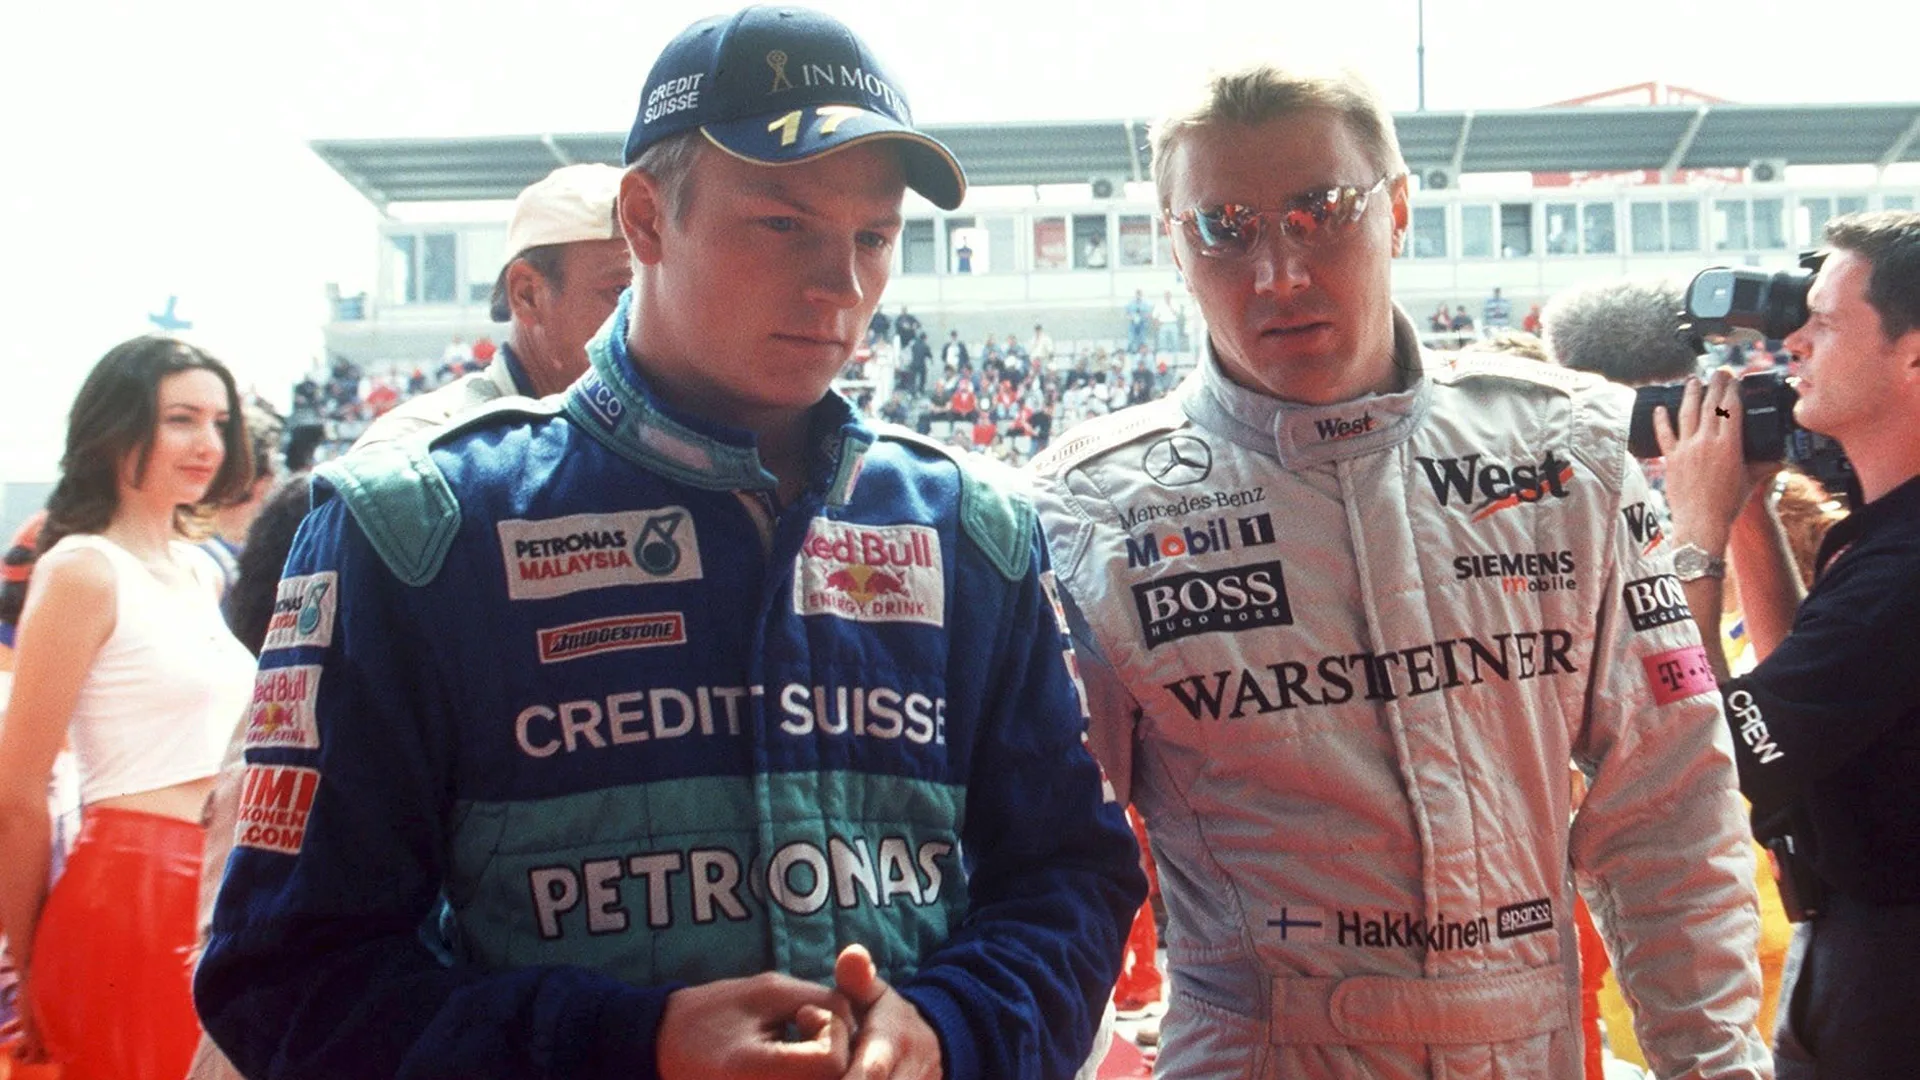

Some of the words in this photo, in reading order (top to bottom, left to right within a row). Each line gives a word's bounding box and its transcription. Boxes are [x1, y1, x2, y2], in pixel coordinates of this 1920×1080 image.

[647, 73, 704, 107] CREDIT
[802, 64, 835, 86] IN
[643, 91, 700, 125] SUISSE
[767, 105, 863, 147] 17
[1313, 411, 1373, 440] West
[1415, 450, 1574, 507] West
[1118, 487, 1266, 531] Mercedes-Benz
[515, 531, 627, 558] PETRONAS
[861, 530, 933, 568] Bull
[1125, 518, 1230, 568] Mobil
[1242, 515, 1267, 545] 1
[519, 550, 632, 580] MALAYSIA
[1453, 551, 1575, 579] SIEMENS
[1143, 571, 1278, 625] BOSS
[1501, 576, 1577, 593] mobile
[872, 601, 926, 616] DRINK
[1151, 613, 1209, 637] HUGO
[1223, 606, 1281, 625] BOSS
[551, 622, 676, 653] BRIDGESTONE
[278, 668, 307, 701] Bull
[1163, 629, 1579, 722] WARSTEINER
[515, 684, 763, 759] CREDIT
[780, 682, 947, 745] SUISSE
[1727, 689, 1785, 764] CREW
[528, 837, 952, 940] PETRONAS
